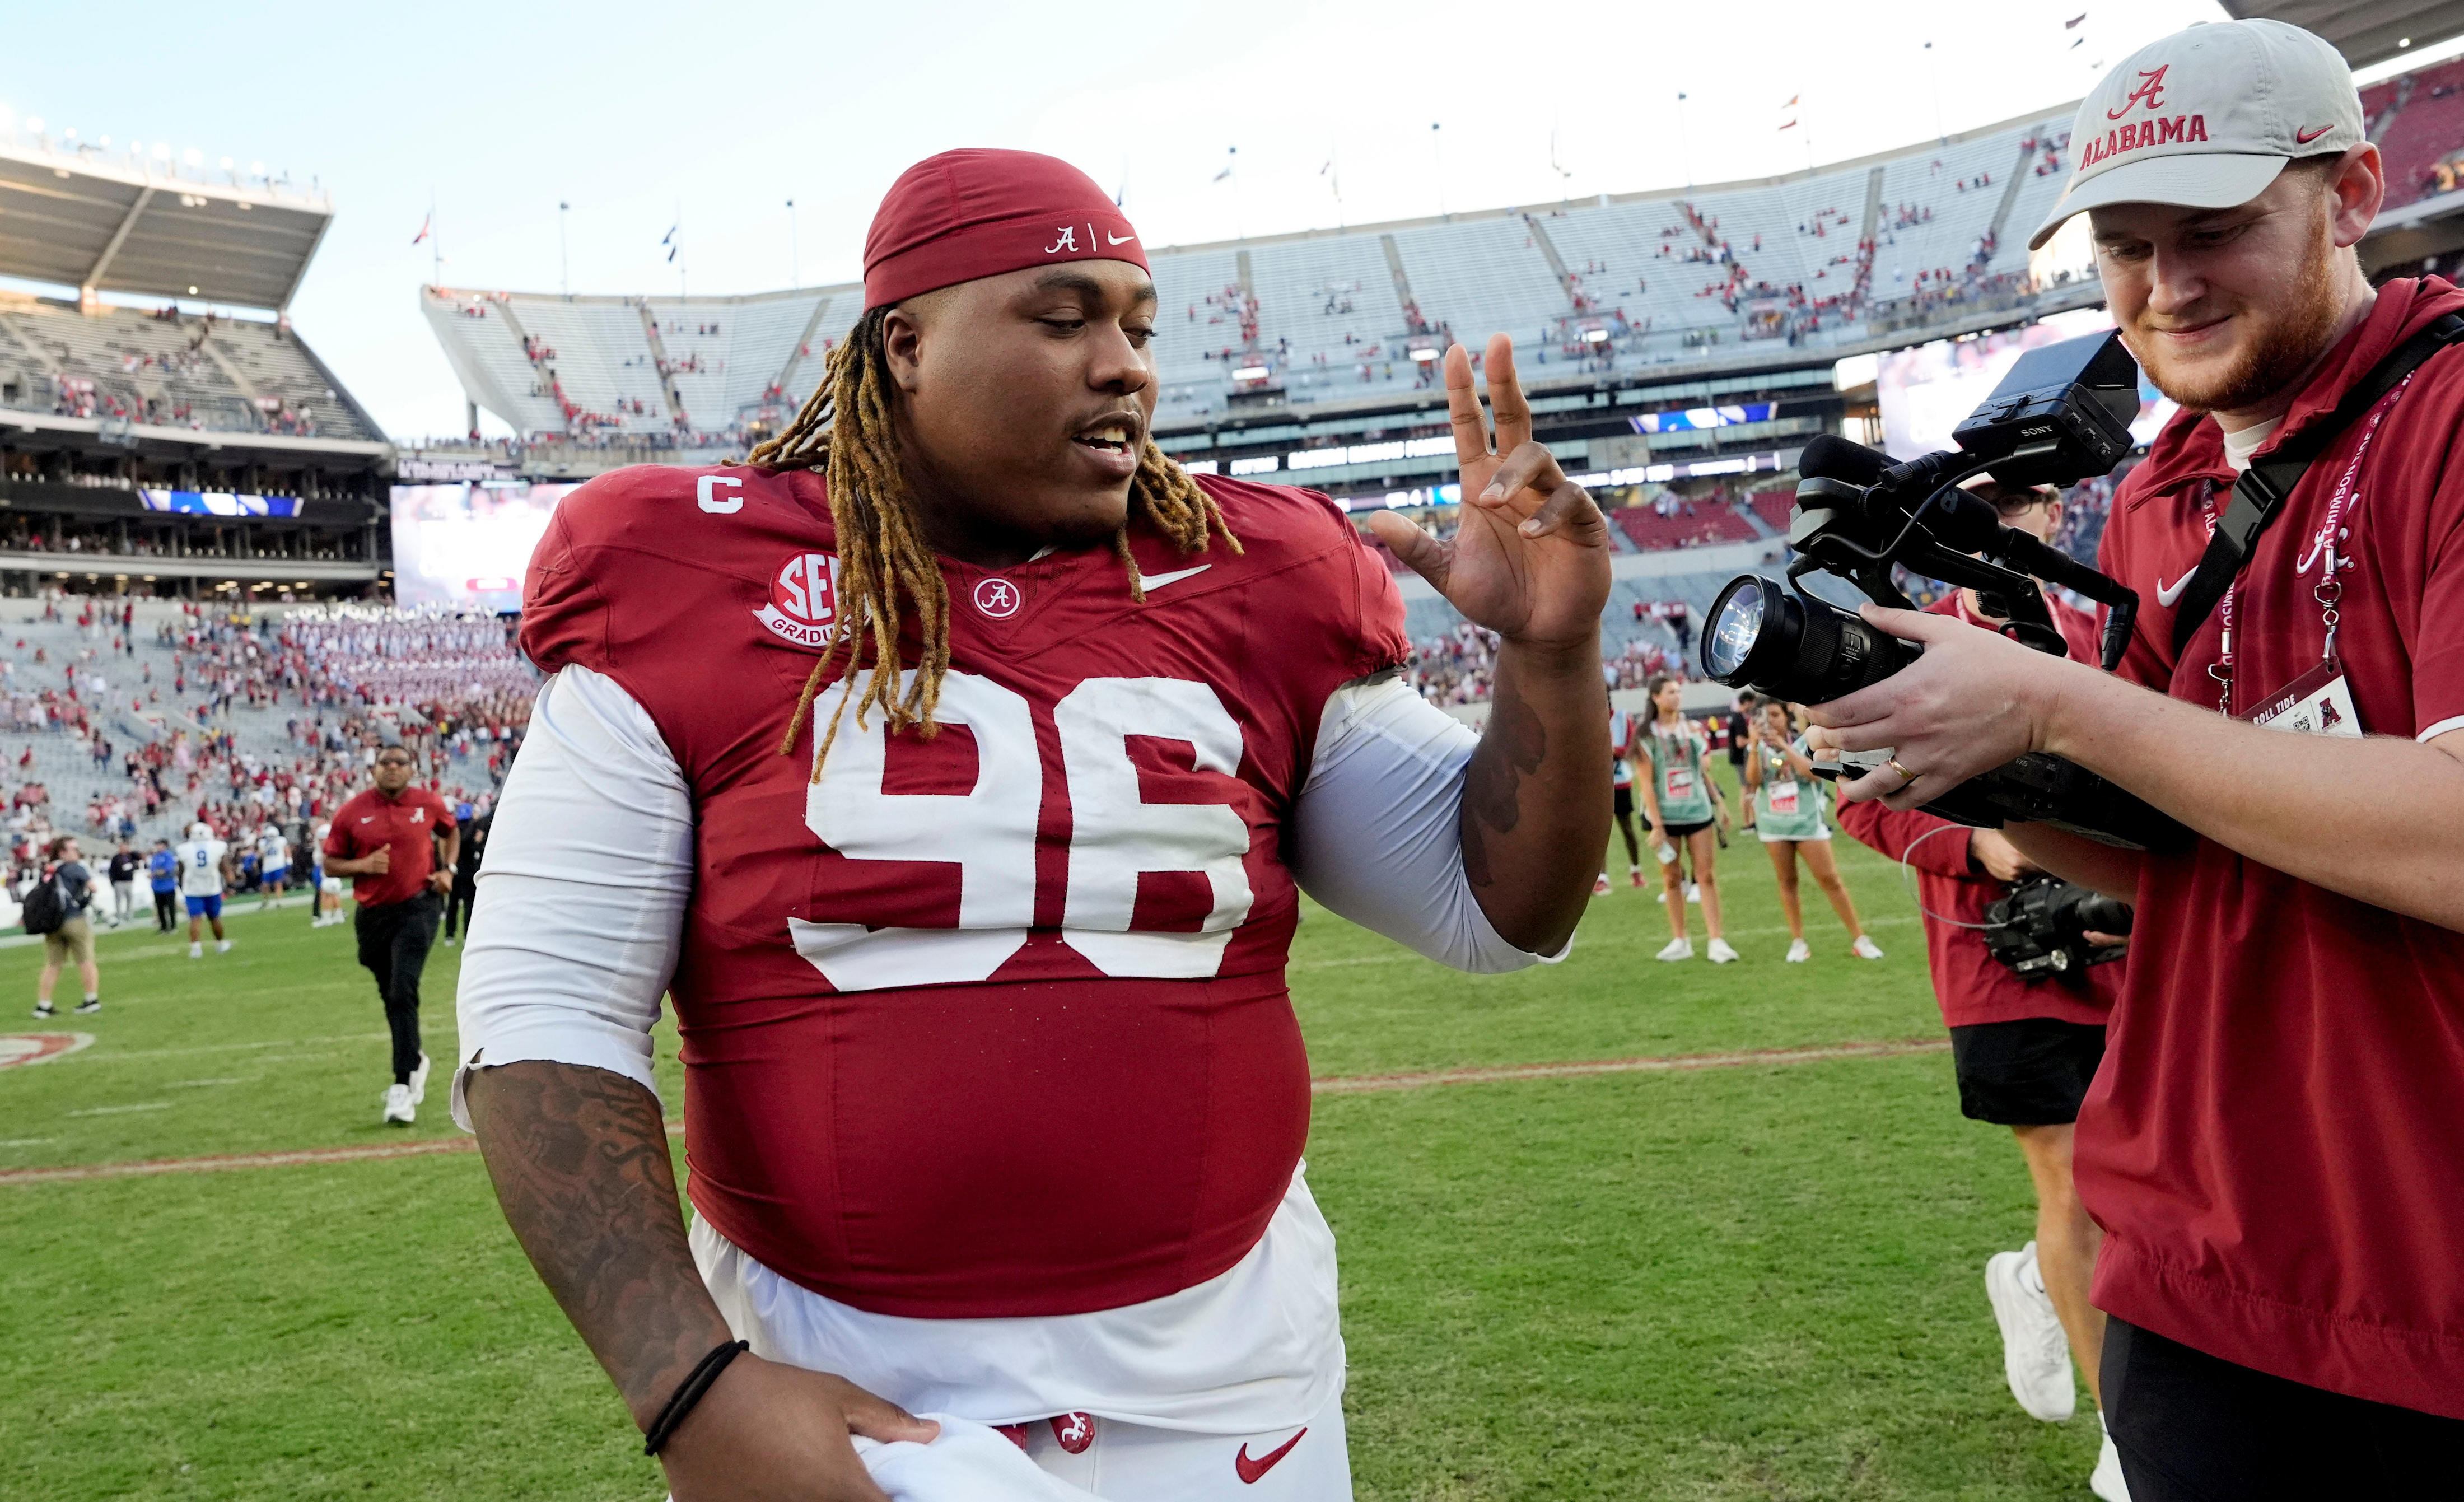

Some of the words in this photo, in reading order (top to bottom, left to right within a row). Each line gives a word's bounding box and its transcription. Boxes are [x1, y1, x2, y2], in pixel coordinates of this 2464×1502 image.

[2107, 64, 2169, 120] A
[2079, 115, 2209, 171] ALABAMA
[1044, 226, 1079, 254] A
[2020, 425, 2053, 436] SONY
[696, 475, 744, 514] C
[2323, 464, 2356, 535] CRIMSON
[981, 584, 1010, 608] A
[2252, 707, 2275, 726] ROLL
[2275, 693, 2296, 714] TIDE
[2016, 758, 2028, 767] FX6
[786, 668, 1254, 992] 96
[197, 850, 207, 867] 9
